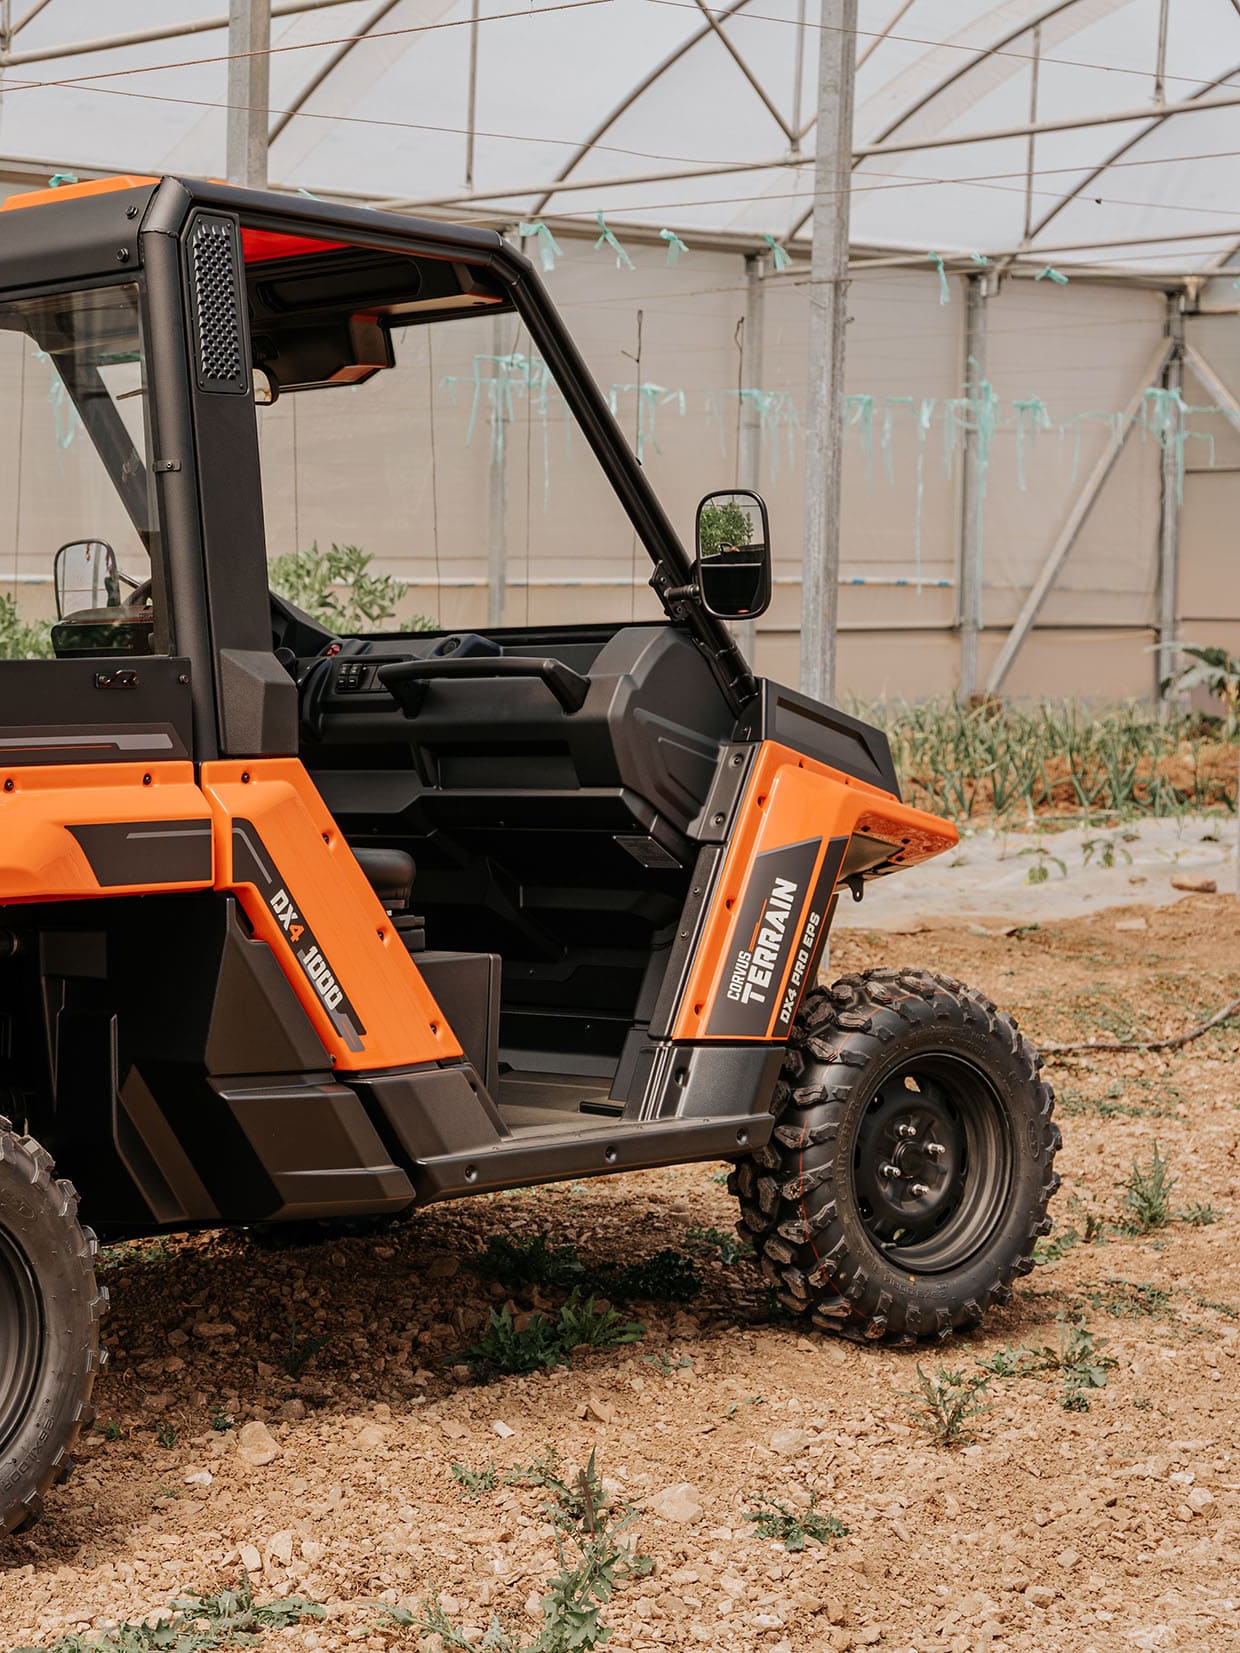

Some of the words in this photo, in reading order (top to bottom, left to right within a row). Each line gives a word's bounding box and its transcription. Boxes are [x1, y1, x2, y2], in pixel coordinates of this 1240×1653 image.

[270, 888, 305, 943] DX4
[303, 945, 343, 1010] 1000
[727, 950, 752, 1001] CORVUS
[741, 877, 798, 1005] TERRAIN
[779, 988, 797, 1024] DX4
[790, 950, 809, 987] PRO
[802, 911, 820, 949] EPS
